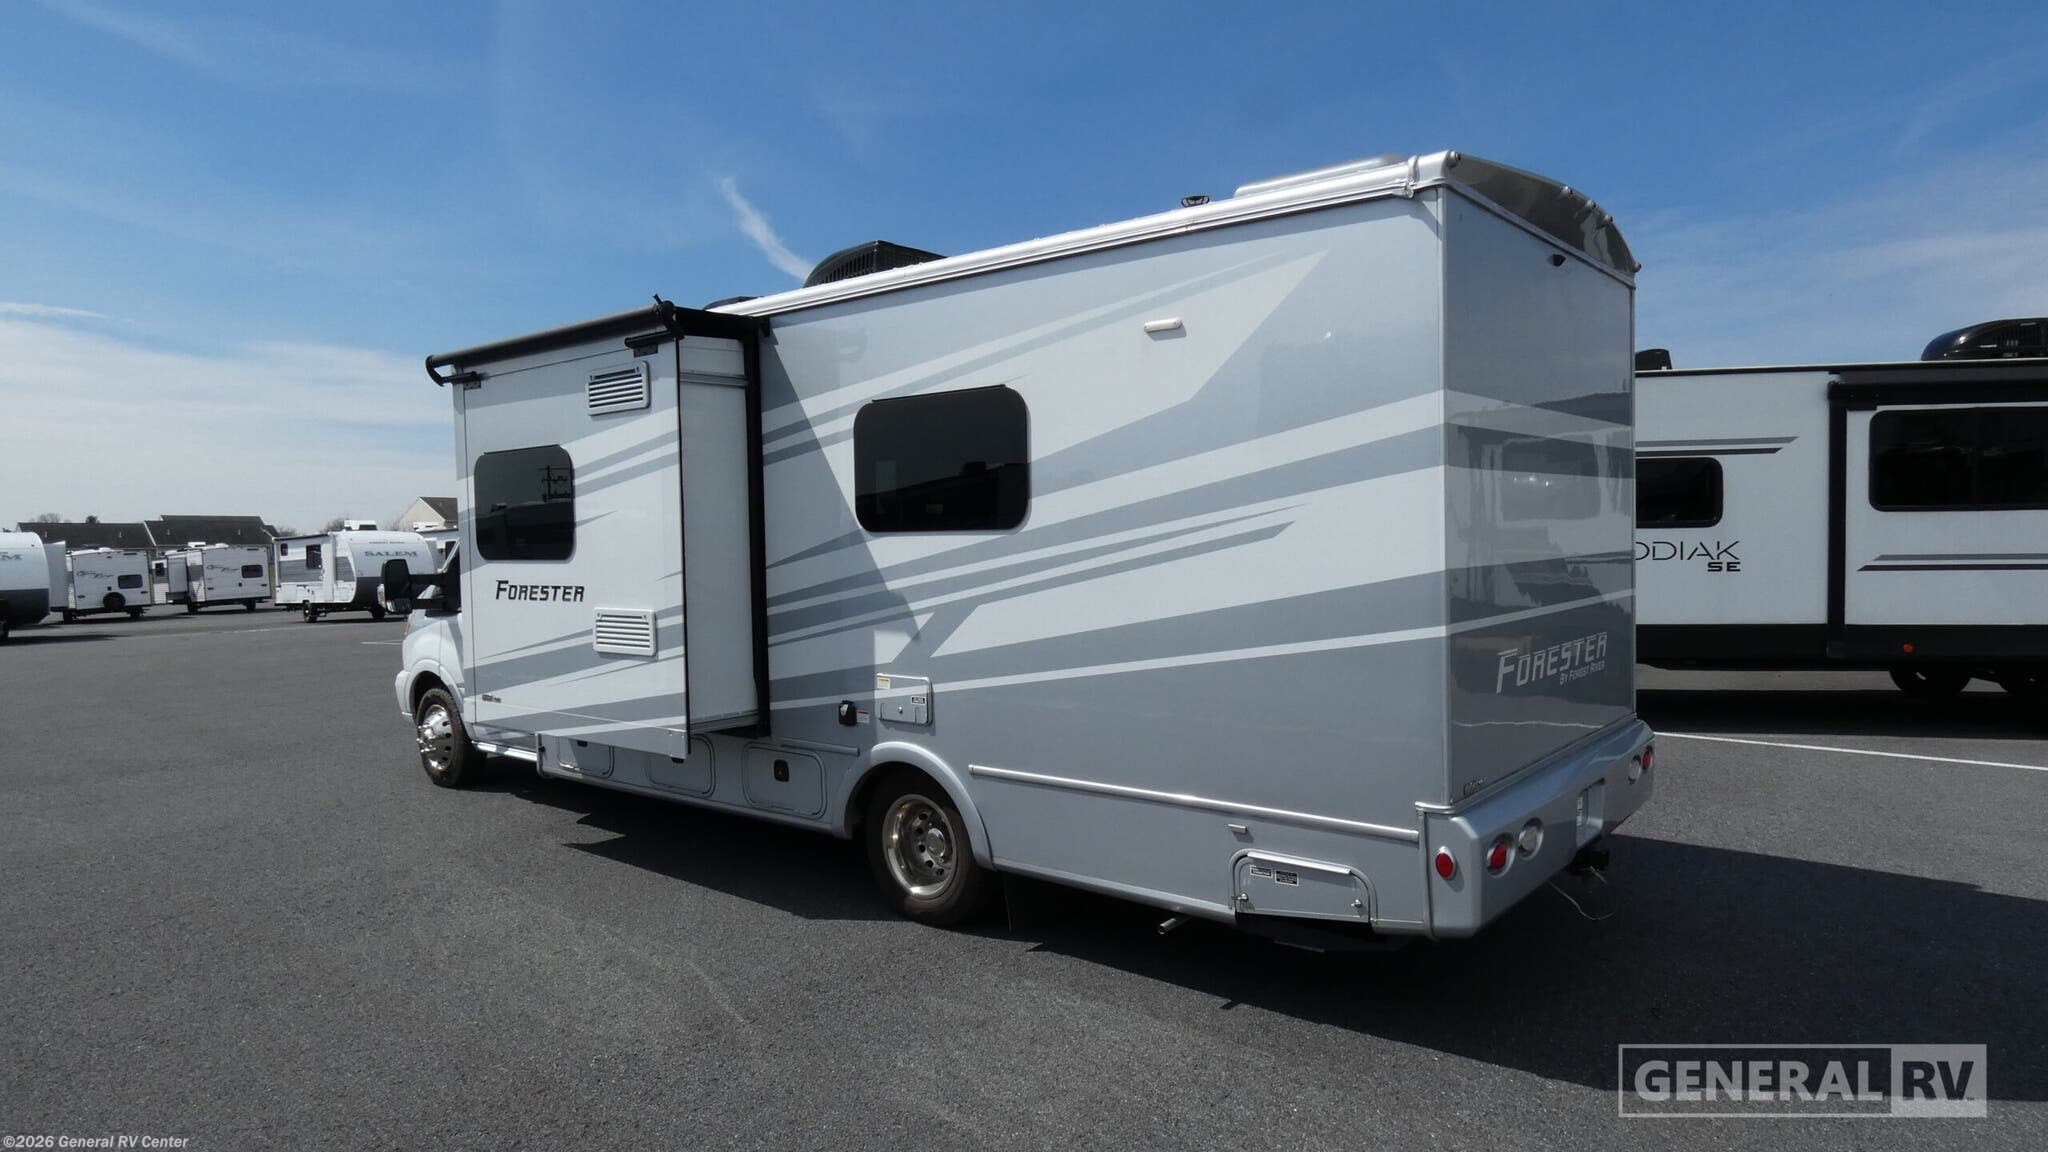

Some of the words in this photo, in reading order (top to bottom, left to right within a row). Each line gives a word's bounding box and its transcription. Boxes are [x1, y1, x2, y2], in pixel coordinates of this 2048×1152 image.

[1707, 561, 1741, 572] SE
[495, 579, 585, 602] FORESTER
[1496, 631, 1608, 694] FORESTER
